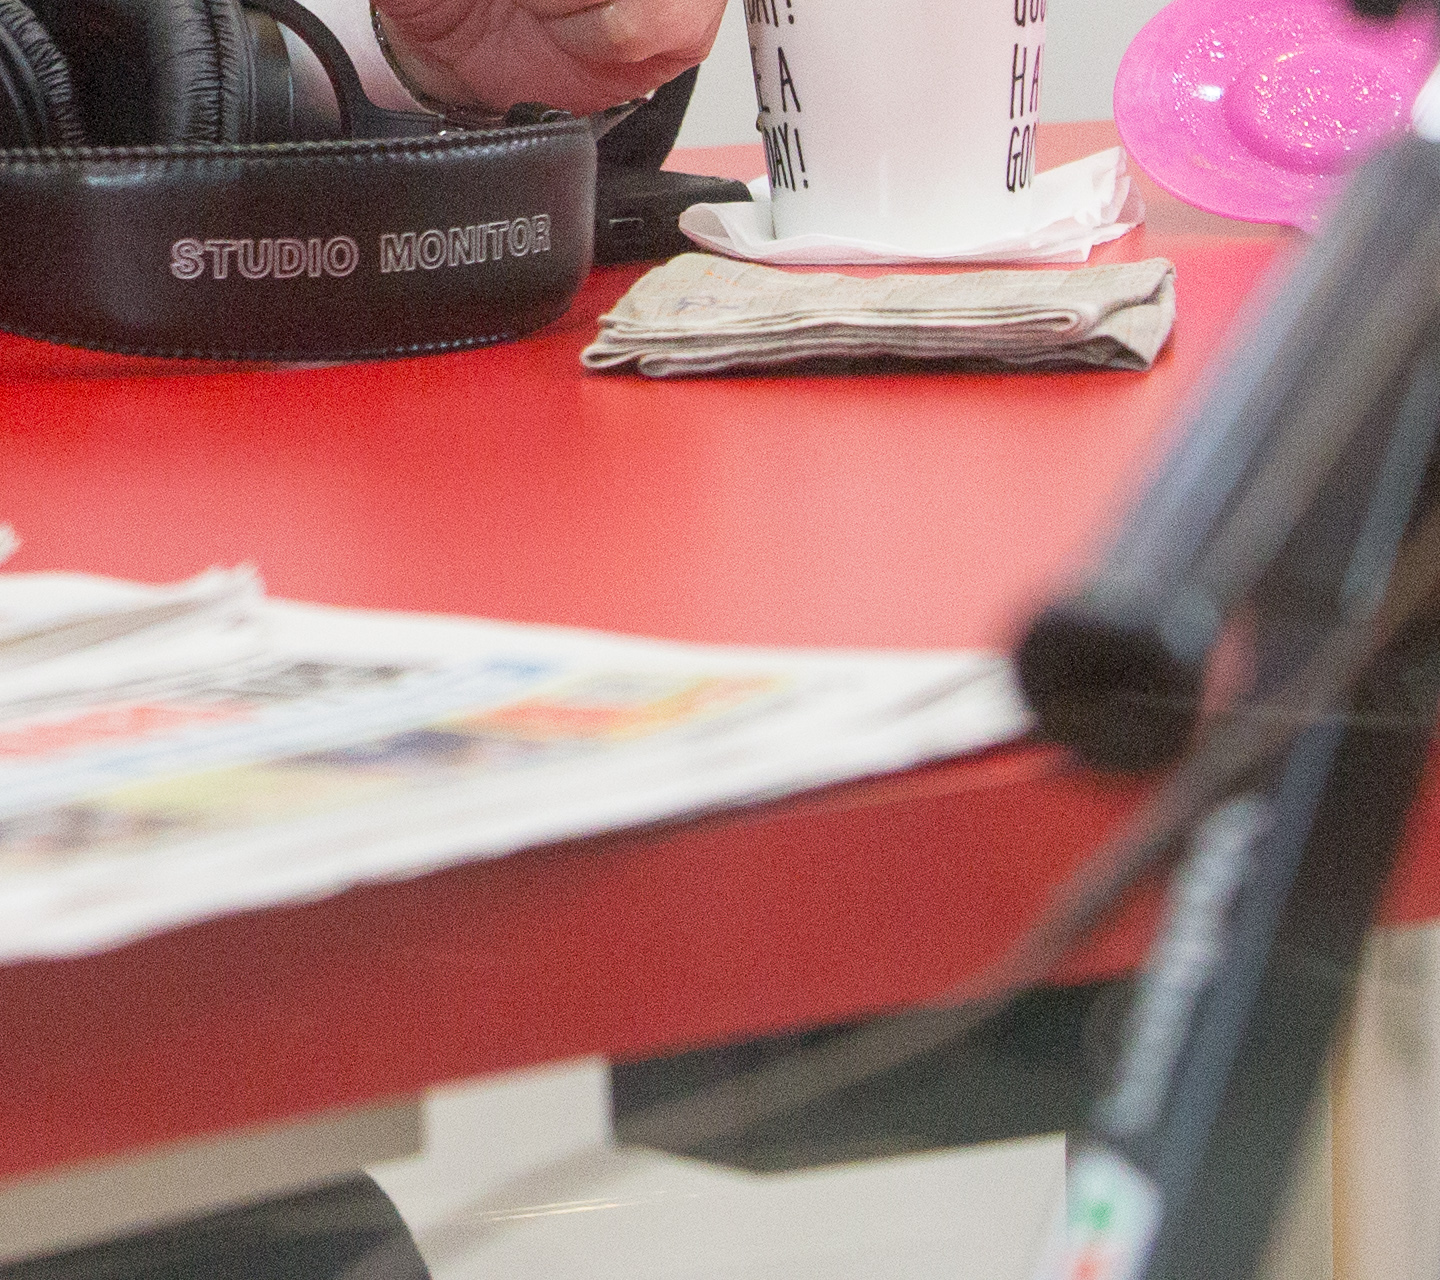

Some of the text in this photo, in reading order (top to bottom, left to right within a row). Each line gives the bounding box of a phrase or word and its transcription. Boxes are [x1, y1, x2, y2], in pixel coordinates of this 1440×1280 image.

[1010, 42, 1044, 120] HA
[170, 214, 551, 280] STUDIO MONITOR
